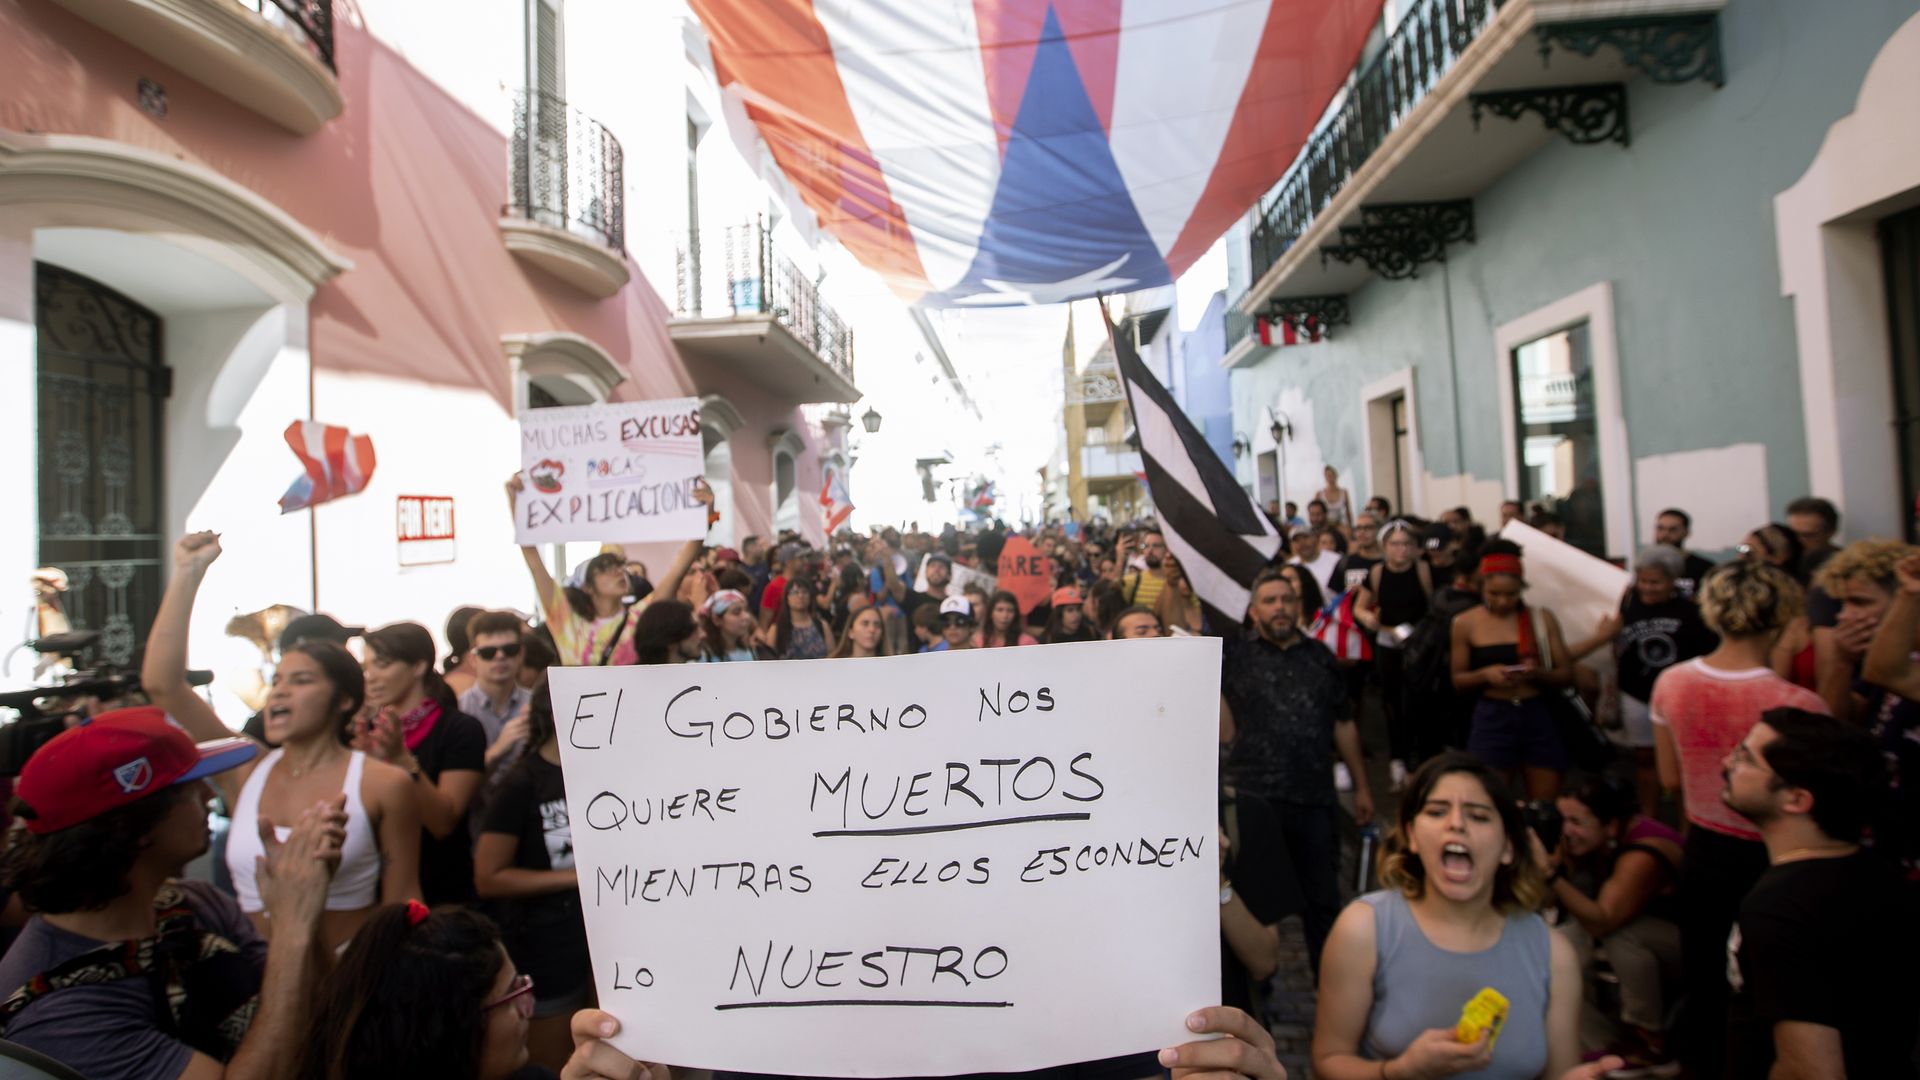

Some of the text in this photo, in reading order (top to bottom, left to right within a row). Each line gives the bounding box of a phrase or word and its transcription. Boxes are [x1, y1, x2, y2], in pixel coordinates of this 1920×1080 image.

[523, 409, 701, 452] MUCHAS EXCUSAS
[587, 456, 645, 478] POCAS
[398, 499, 453, 538] FOR RENT
[665, 686, 927, 747] GOBIERNO
[979, 682, 1055, 723] NOS
[586, 752, 1104, 832] QUIERE MUERTOS
[597, 836, 1205, 907] MIENTRAS ELLOS ESCONDEN
[614, 940, 1009, 997] LO NUESTRO
